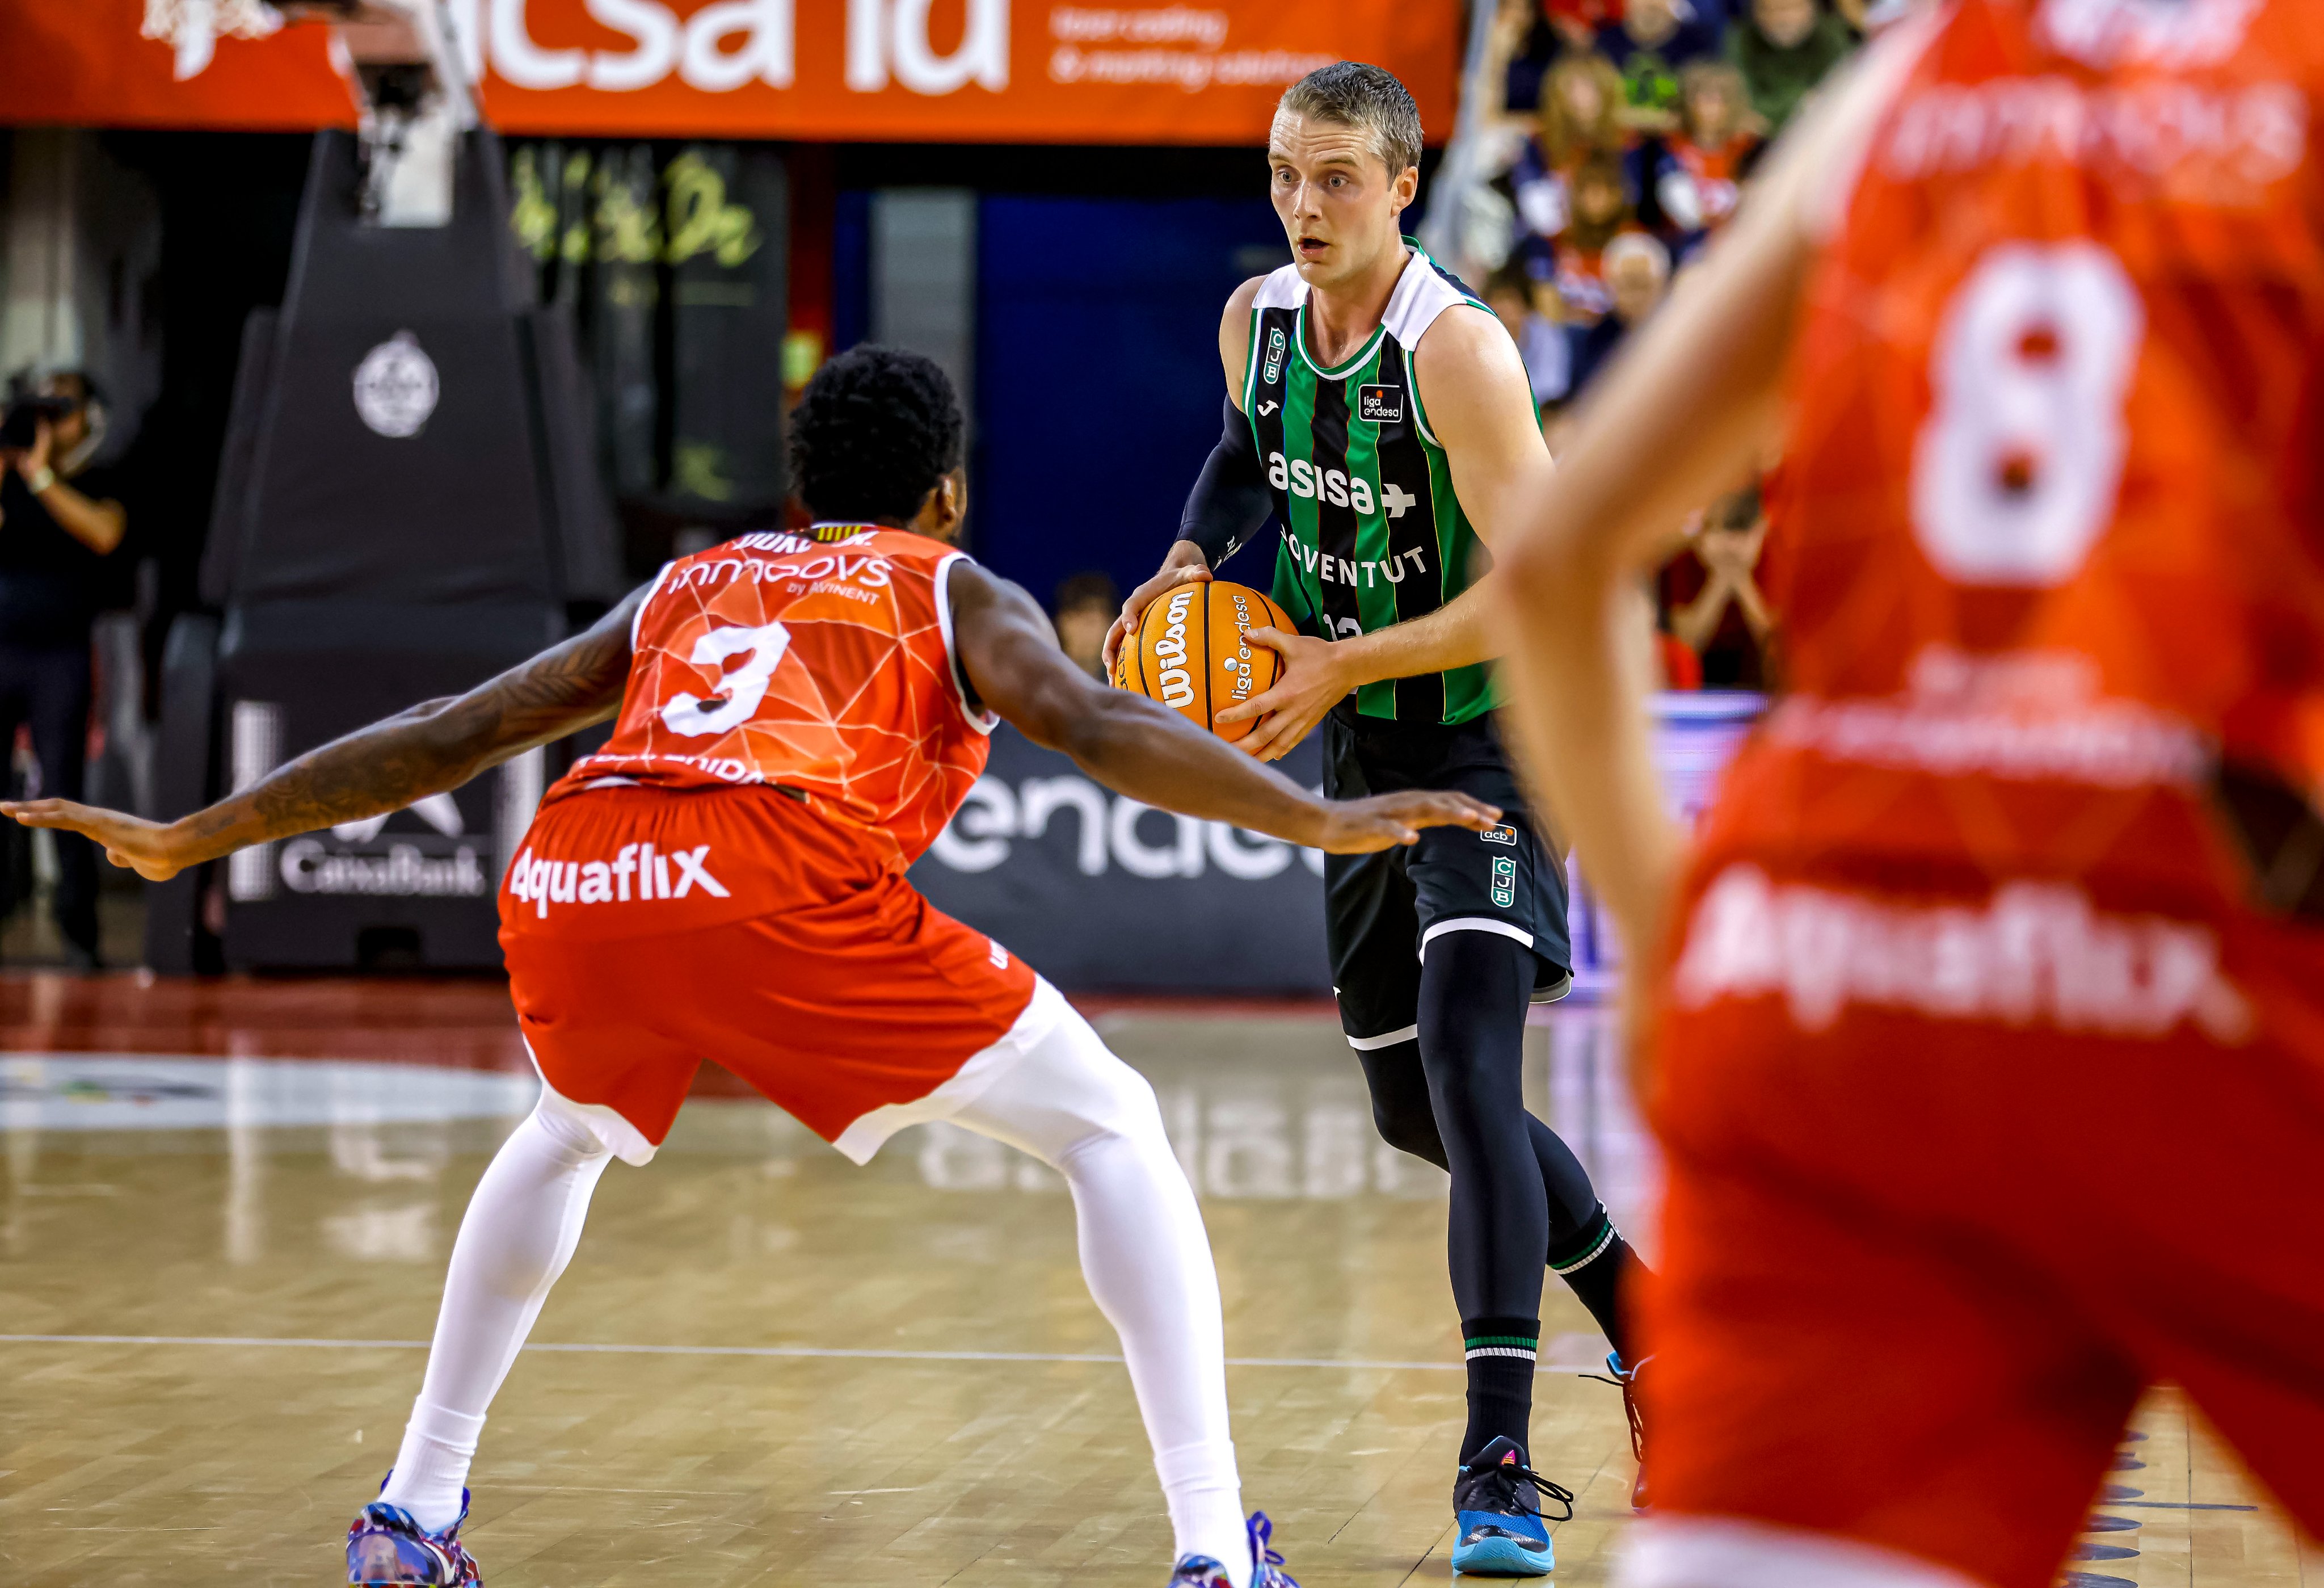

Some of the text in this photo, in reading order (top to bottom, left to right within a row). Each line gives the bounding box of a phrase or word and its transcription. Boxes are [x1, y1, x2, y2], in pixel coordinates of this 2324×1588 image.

[1364, 396, 1381, 407] liga
[1364, 407, 1399, 417] endesa
[1908, 238, 2146, 591] 8
[1269, 451, 1375, 515] asisa
[809, 581, 881, 606] AVINENT
[660, 620, 791, 737] 3
[1155, 591, 1195, 709] Wilson
[1231, 595, 1253, 701] liga endesa
[931, 774, 1324, 880] ende
[1484, 830, 1508, 842] acb
